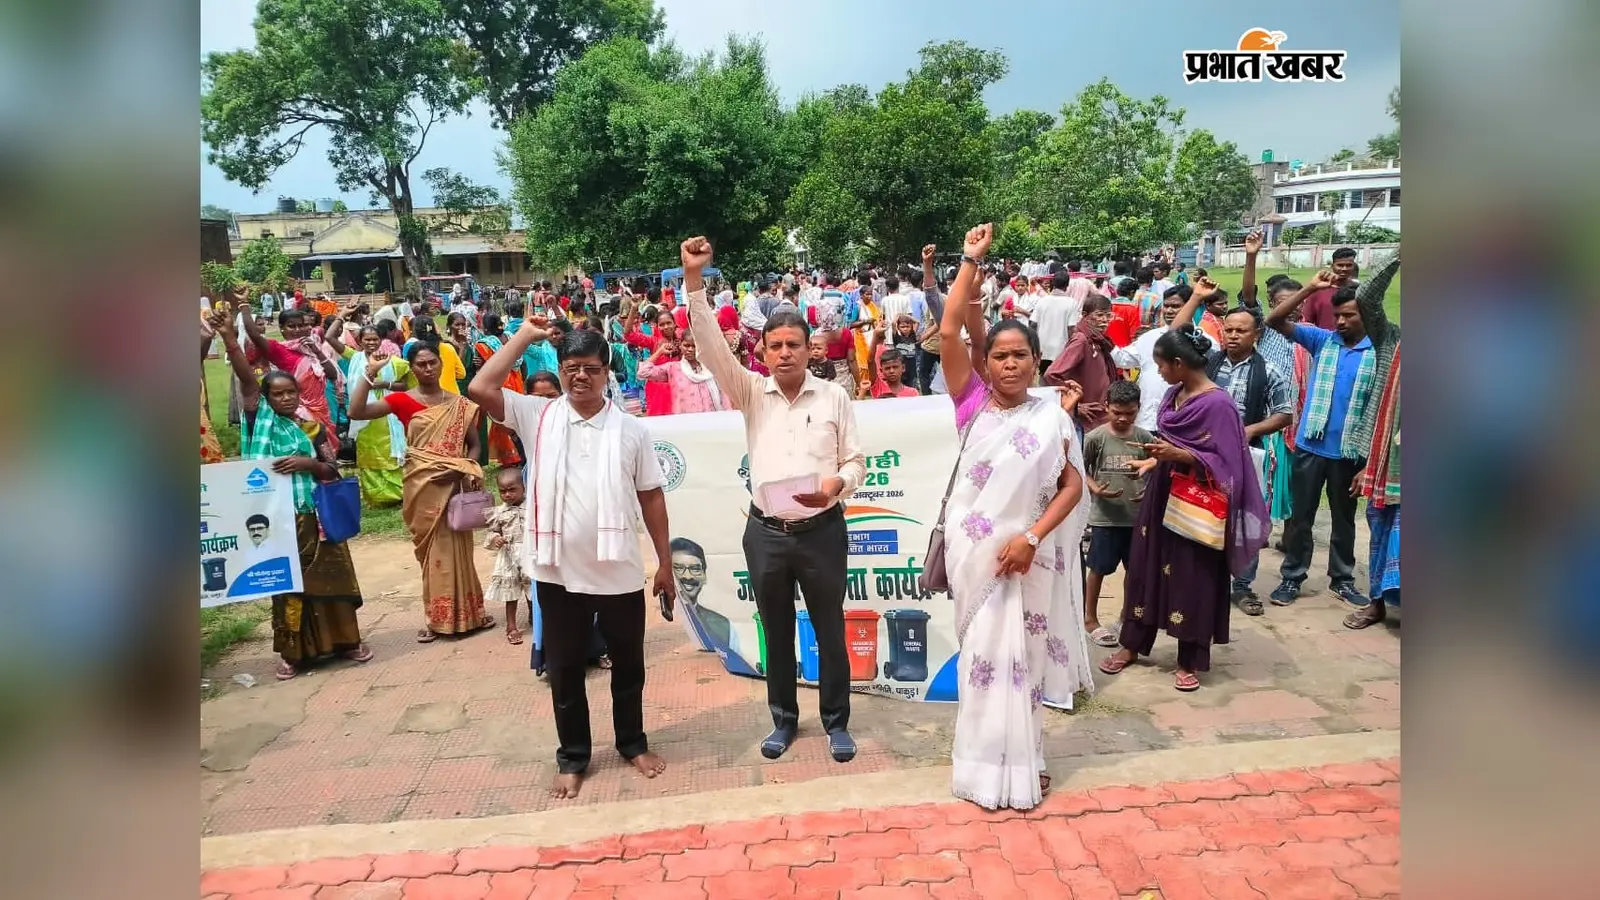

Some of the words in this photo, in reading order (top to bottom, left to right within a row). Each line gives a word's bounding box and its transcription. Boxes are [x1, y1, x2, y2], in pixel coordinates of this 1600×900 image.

[864, 472, 889, 487] 26
[853, 491, 884, 502] अक्टूबर
[886, 490, 904, 498] 2026
[866, 544, 889, 553] भारत
